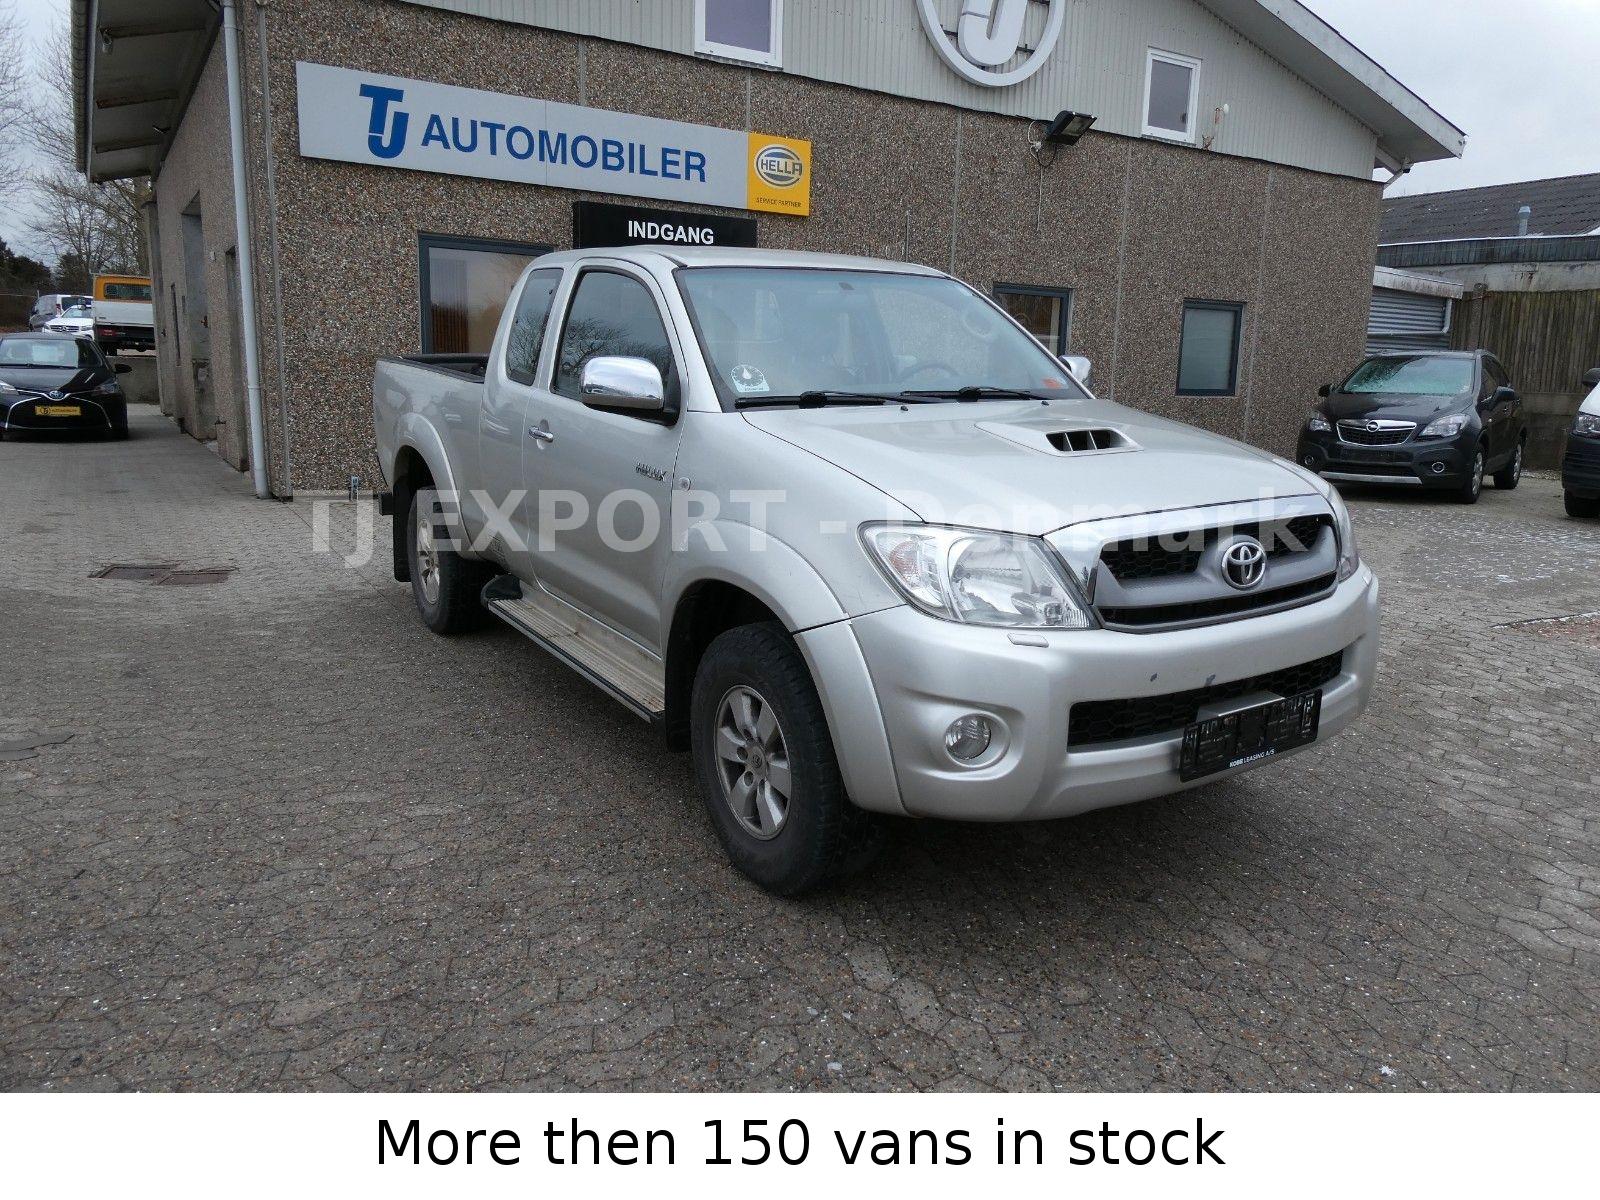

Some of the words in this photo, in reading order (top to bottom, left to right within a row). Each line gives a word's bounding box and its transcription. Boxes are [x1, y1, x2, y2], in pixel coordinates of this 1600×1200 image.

[359, 84, 409, 159] TJ
[421, 114, 706, 182] AUTOMOBILER
[761, 159, 803, 176] HELLA
[756, 197, 777, 205] SERVICE
[778, 200, 802, 208] PARTNER
[628, 220, 714, 245] INDGANG
[1244, 752, 1265, 763] LEASING
